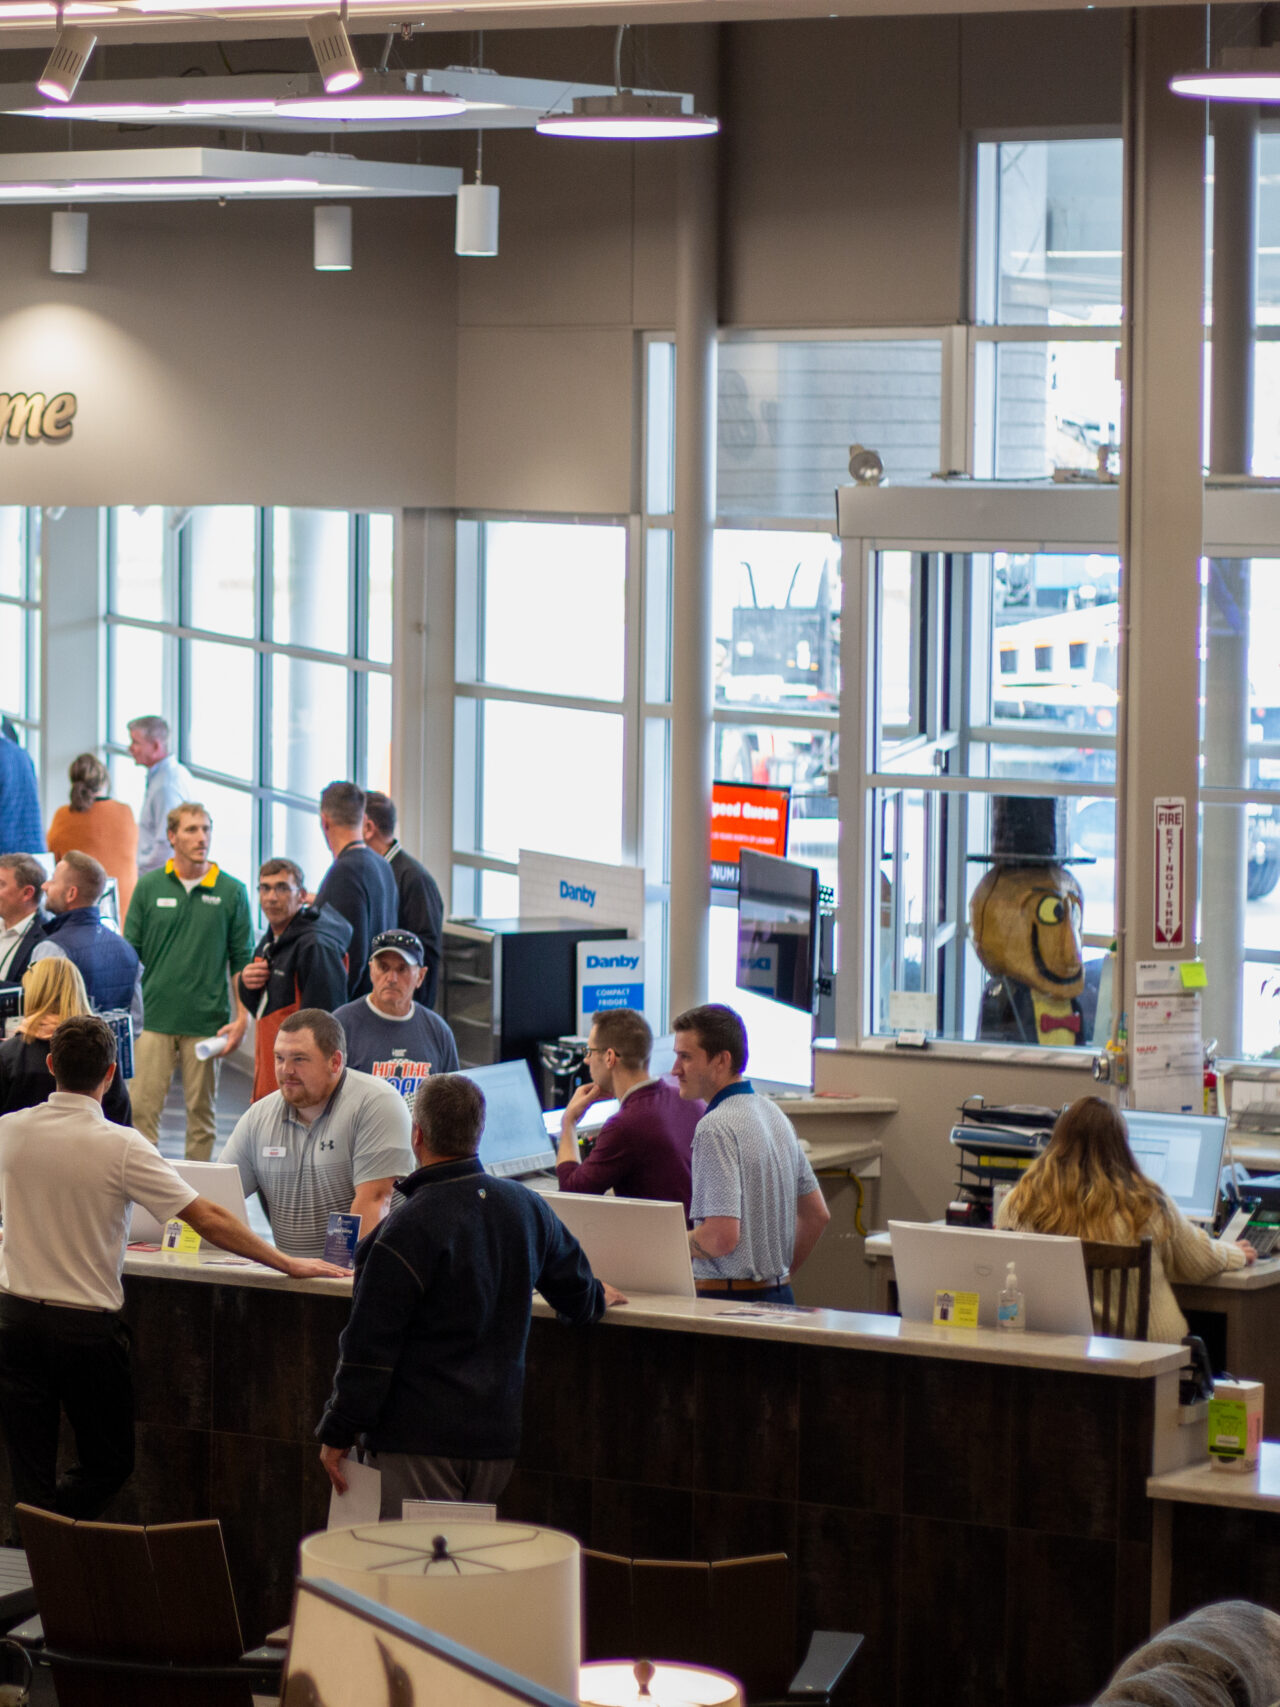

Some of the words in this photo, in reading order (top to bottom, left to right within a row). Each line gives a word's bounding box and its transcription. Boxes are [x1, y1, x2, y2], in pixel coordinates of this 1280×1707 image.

[711, 801, 741, 819] peed
[742, 802, 779, 821] Queen
[1158, 812, 1181, 825] FIRE
[1165, 828, 1174, 935] EXTINGUISHER
[559, 880, 597, 908] Danby
[586, 955, 640, 970] Danby
[596, 988, 630, 997] COMPACT
[372, 1061, 398, 1077] HIT
[400, 1061, 432, 1077] THE
